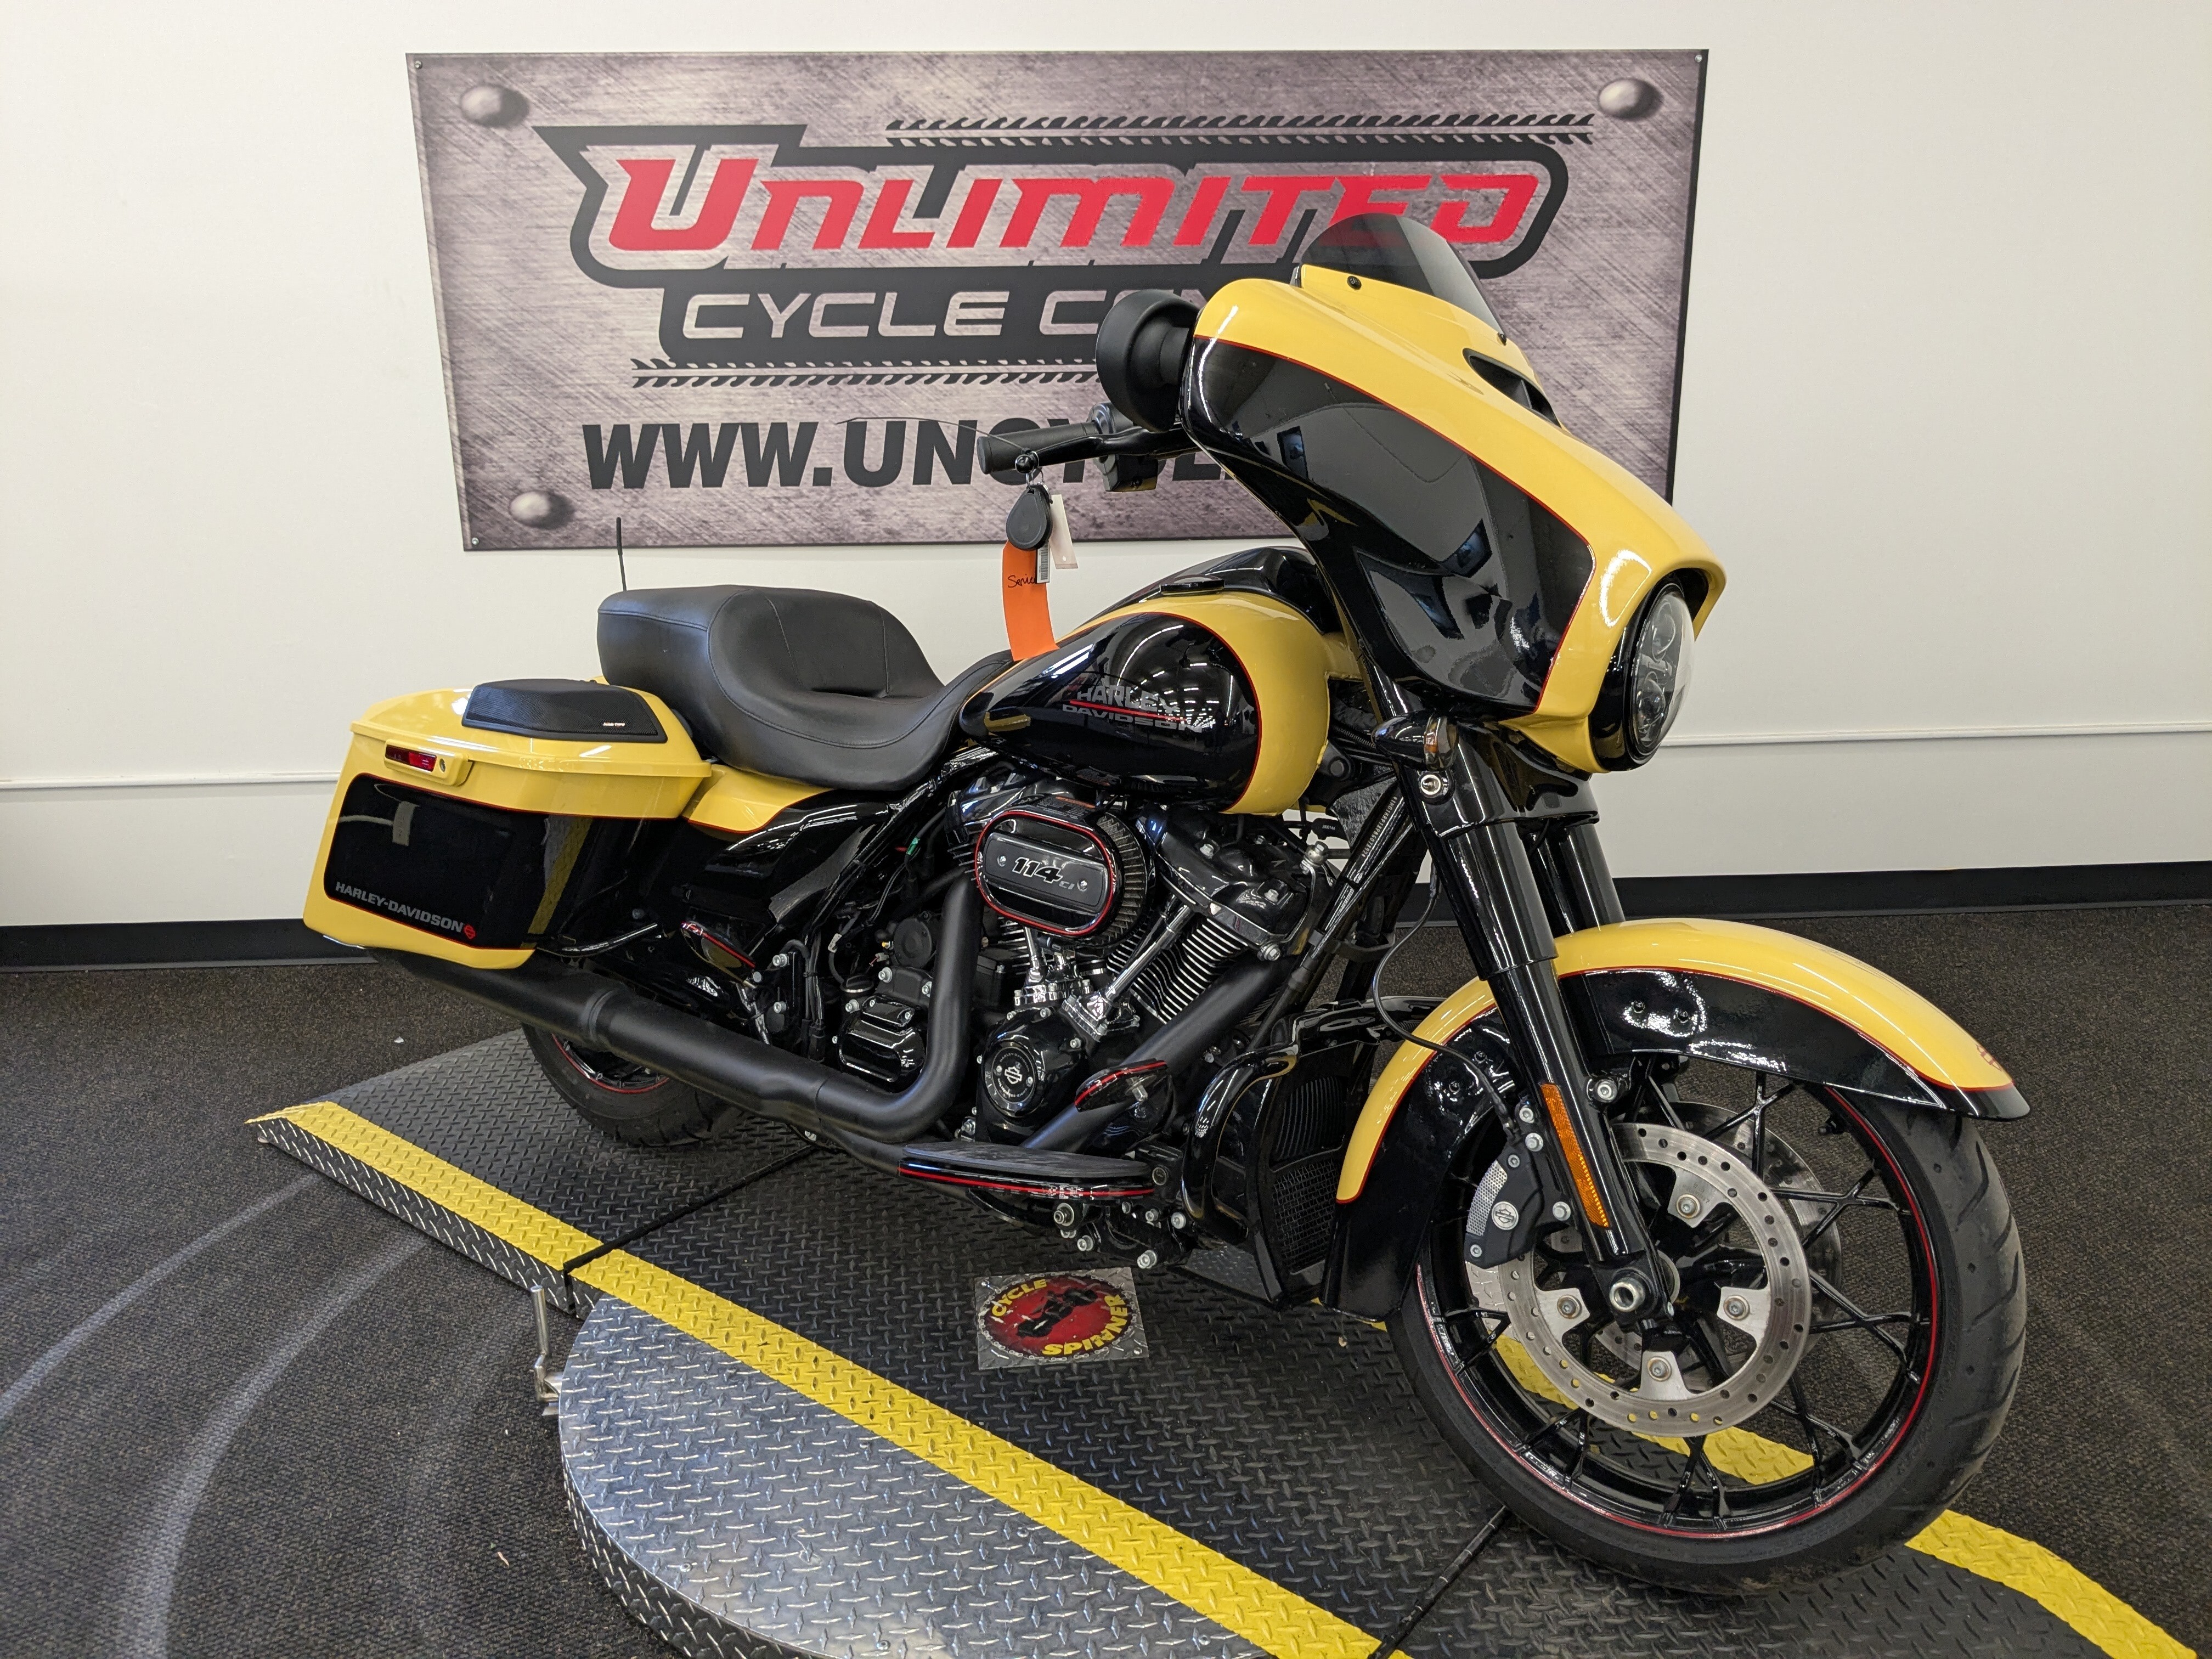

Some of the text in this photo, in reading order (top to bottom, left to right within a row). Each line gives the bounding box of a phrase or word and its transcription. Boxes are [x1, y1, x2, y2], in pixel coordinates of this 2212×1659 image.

[608, 159, 1539, 250] UNLIMITED
[682, 291, 1009, 338] CYCLE
[1062, 703, 1203, 733] DAVIDSON
[1077, 685, 1180, 714] HARLEY
[1012, 856, 1075, 890] 114 CI
[335, 881, 464, 933] HARLEY-DAVIDSON
[991, 1279, 1047, 1317] CYCLE
[1042, 1294, 1128, 1355] SPINNER
